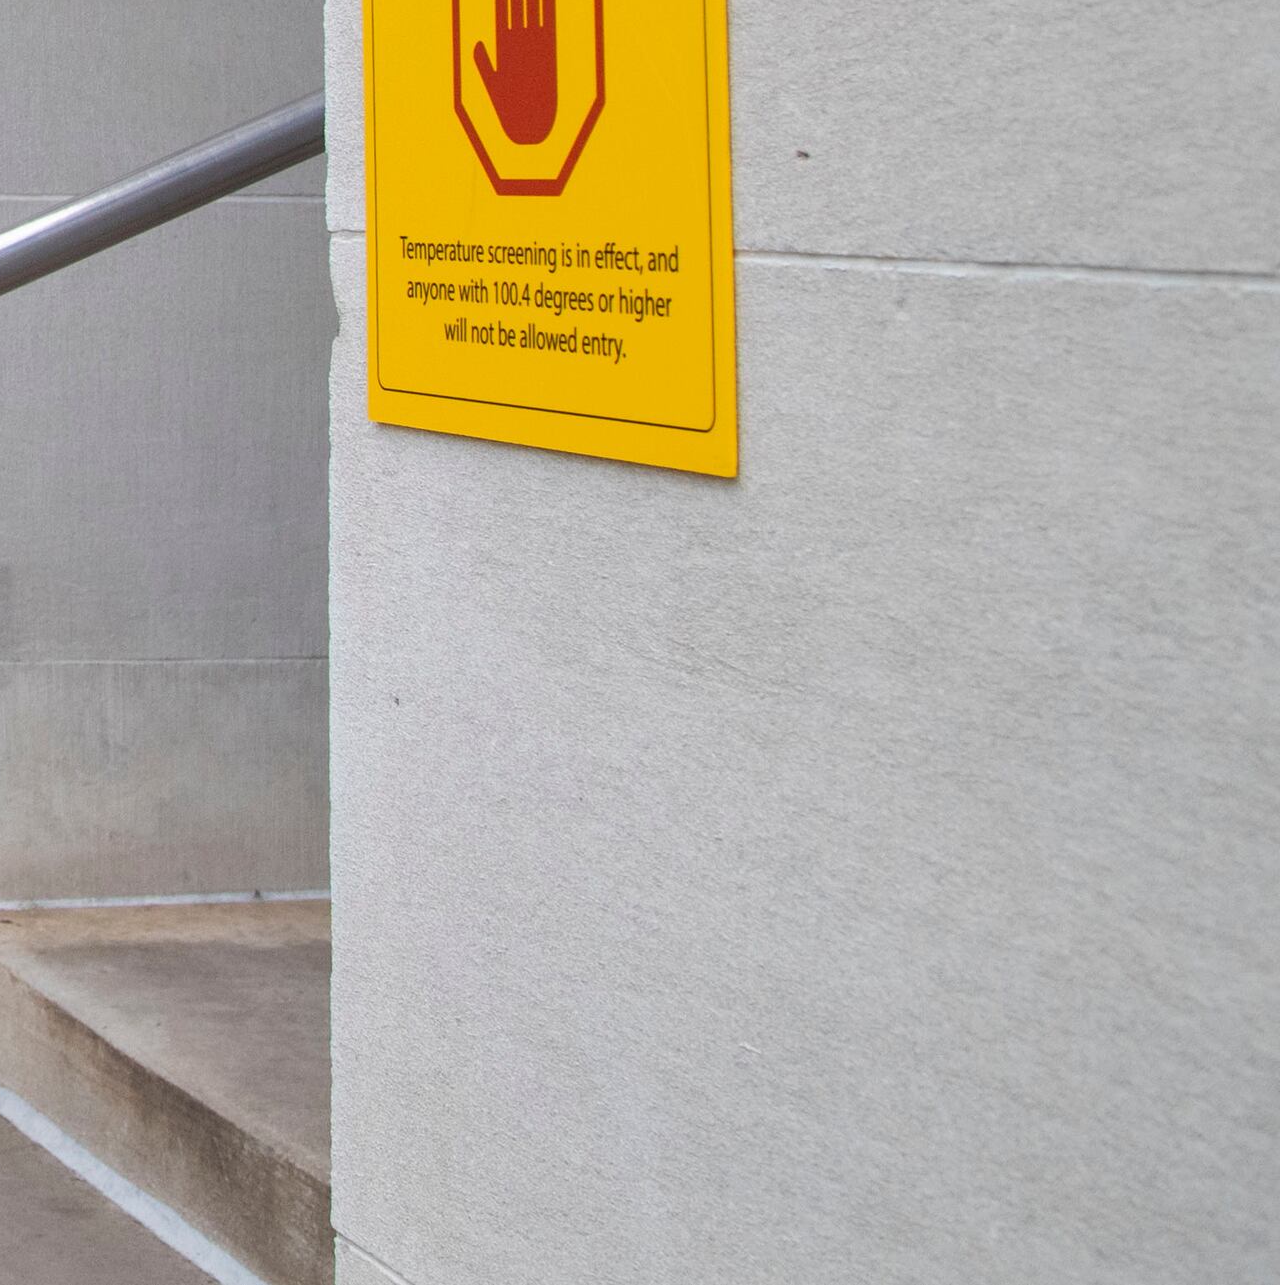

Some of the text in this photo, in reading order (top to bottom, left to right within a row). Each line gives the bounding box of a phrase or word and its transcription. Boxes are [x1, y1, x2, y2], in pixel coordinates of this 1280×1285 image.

[400, 236, 679, 274] Temperature screening is in effect, and
[407, 279, 672, 322] anyone with 100.4 degrees or higher
[445, 318, 626, 364] will not be allowed entry.
